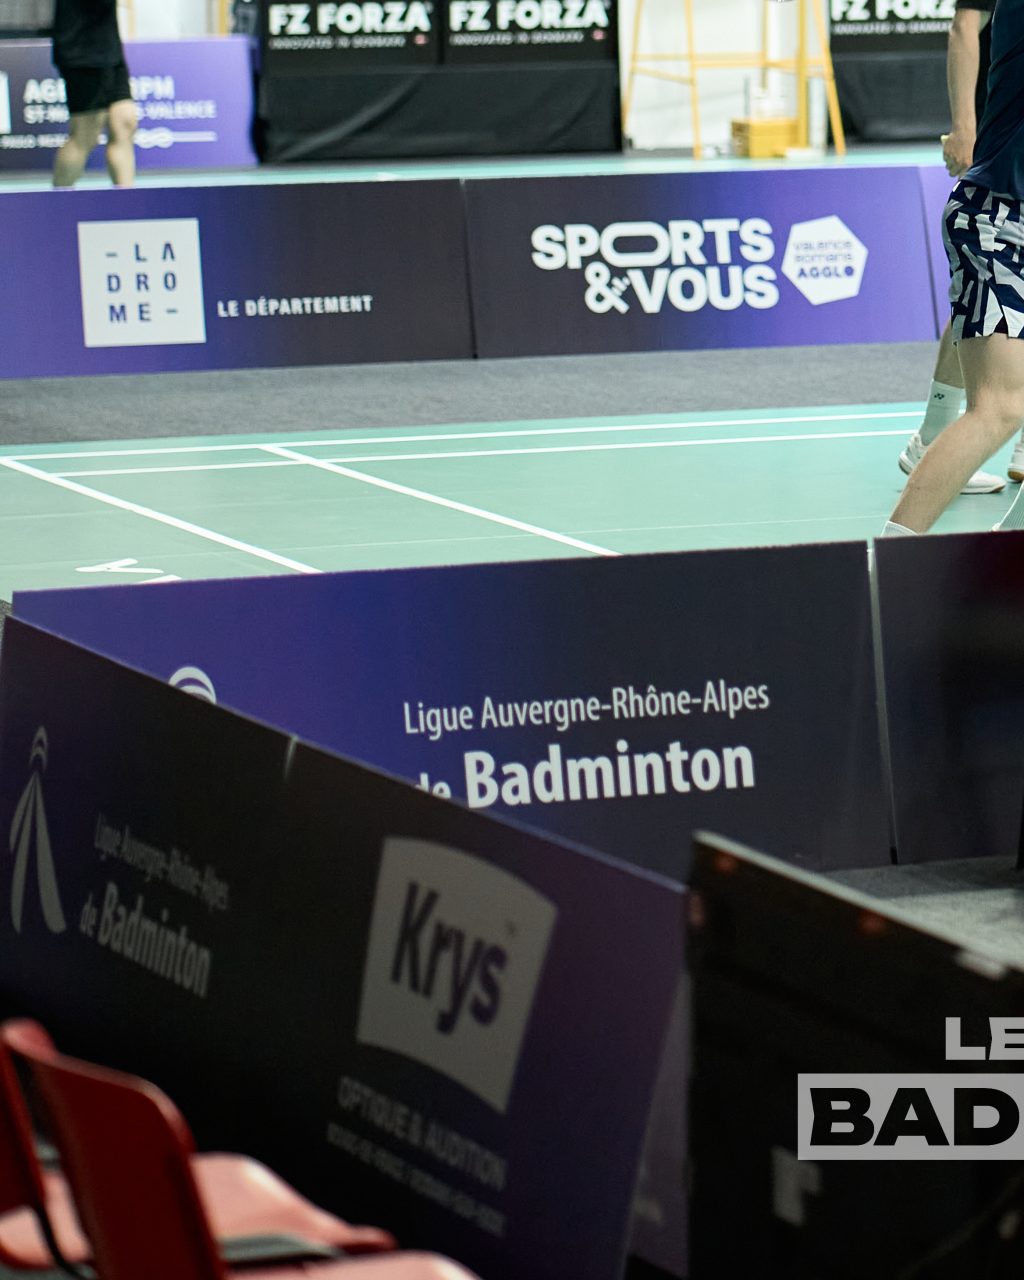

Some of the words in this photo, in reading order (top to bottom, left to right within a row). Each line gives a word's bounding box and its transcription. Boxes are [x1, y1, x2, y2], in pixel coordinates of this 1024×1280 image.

[268, 3, 310, 36] FZ
[317, 1, 431, 35] FORZA
[450, 0, 491, 32] FZ
[531, 218, 775, 270] SPORTS
[107, 271, 176, 293] DRO
[217, 300, 239, 317] LE
[245, 294, 373, 317] DÉPARTEMENT
[403, 701, 473, 741] Ligue
[480, 678, 770, 732] Auvergne-Rhône-Alpes
[464, 739, 756, 809] Badminton
[98, 881, 212, 999] Badminton
[390, 880, 508, 1036] Krys
